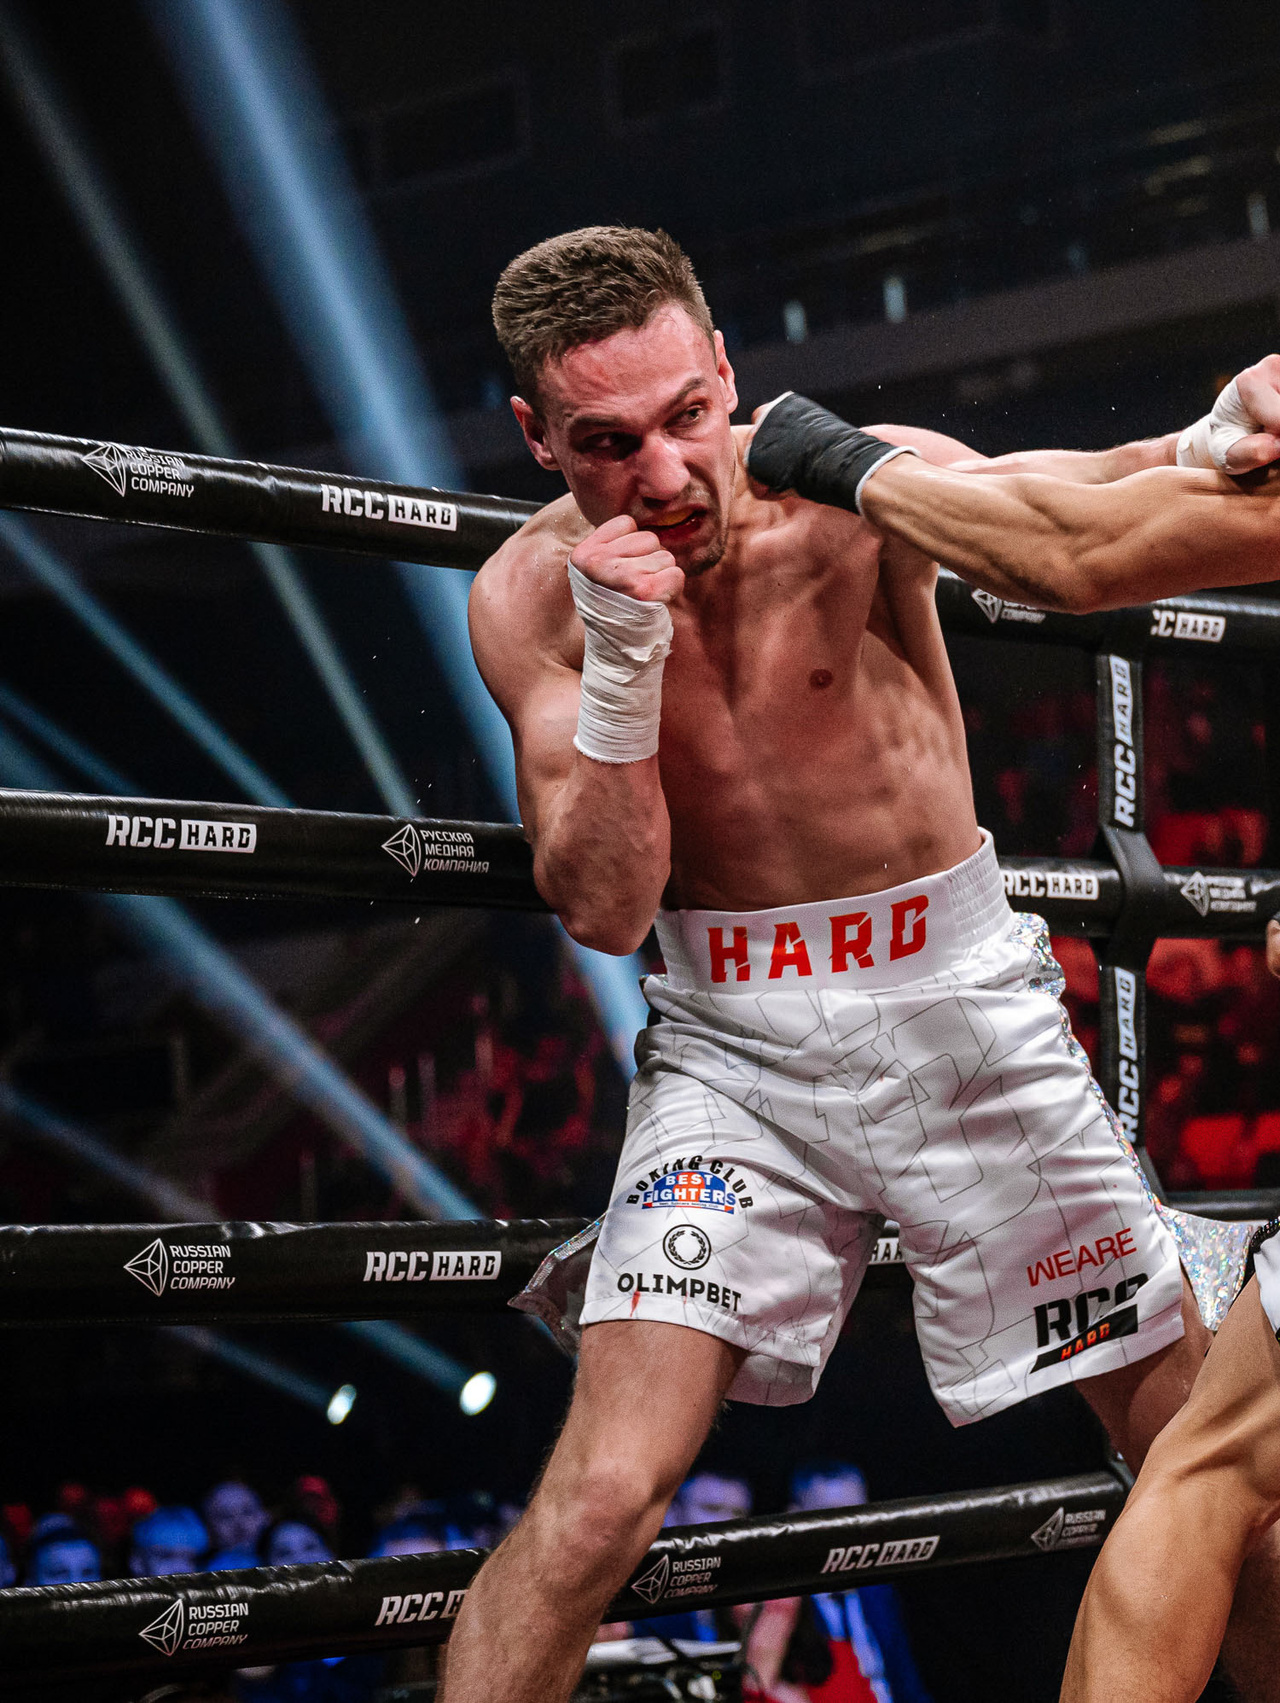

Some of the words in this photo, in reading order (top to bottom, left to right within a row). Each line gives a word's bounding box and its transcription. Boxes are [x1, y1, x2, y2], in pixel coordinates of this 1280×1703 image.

[125, 449, 186, 467] RUSSIAN
[129, 462, 181, 481] COPPER
[131, 477, 195, 498] COMPANY
[320, 483, 385, 520] RCC
[393, 498, 453, 527] HARD
[1113, 743, 1136, 828] RCC
[106, 814, 177, 849] RCC
[184, 821, 254, 850] HARD
[420, 829, 474, 844] РУССКАЯ
[424, 843, 475, 858] МЕДНАЯ
[423, 858, 490, 874] КОМПАНИЯ
[1049, 875, 1096, 898] HARD
[707, 894, 929, 983] HARD
[665, 1174, 713, 1187] BEST
[709, 1159, 754, 1209] CLUB
[643, 1187, 736, 1206] FIGHTERS
[169, 1245, 231, 1258] RUSSIAN
[173, 1260, 224, 1274] COPPER
[363, 1251, 429, 1282] RCC
[435, 1253, 498, 1278] HARD
[170, 1276, 236, 1290] COMPANY
[617, 1272, 742, 1312] OLIMPBET
[1060, 1322, 1111, 1361] HARD
[672, 1556, 722, 1573] RUSSIAN
[820, 1543, 881, 1574] RCC
[880, 1538, 935, 1565] HARD
[669, 1572, 712, 1587] COPPER
[188, 1602, 250, 1620] RUSSIAN
[374, 1591, 445, 1627] RCC
[188, 1619, 240, 1637] COPPER
[182, 1633, 248, 1650] COMPANY
